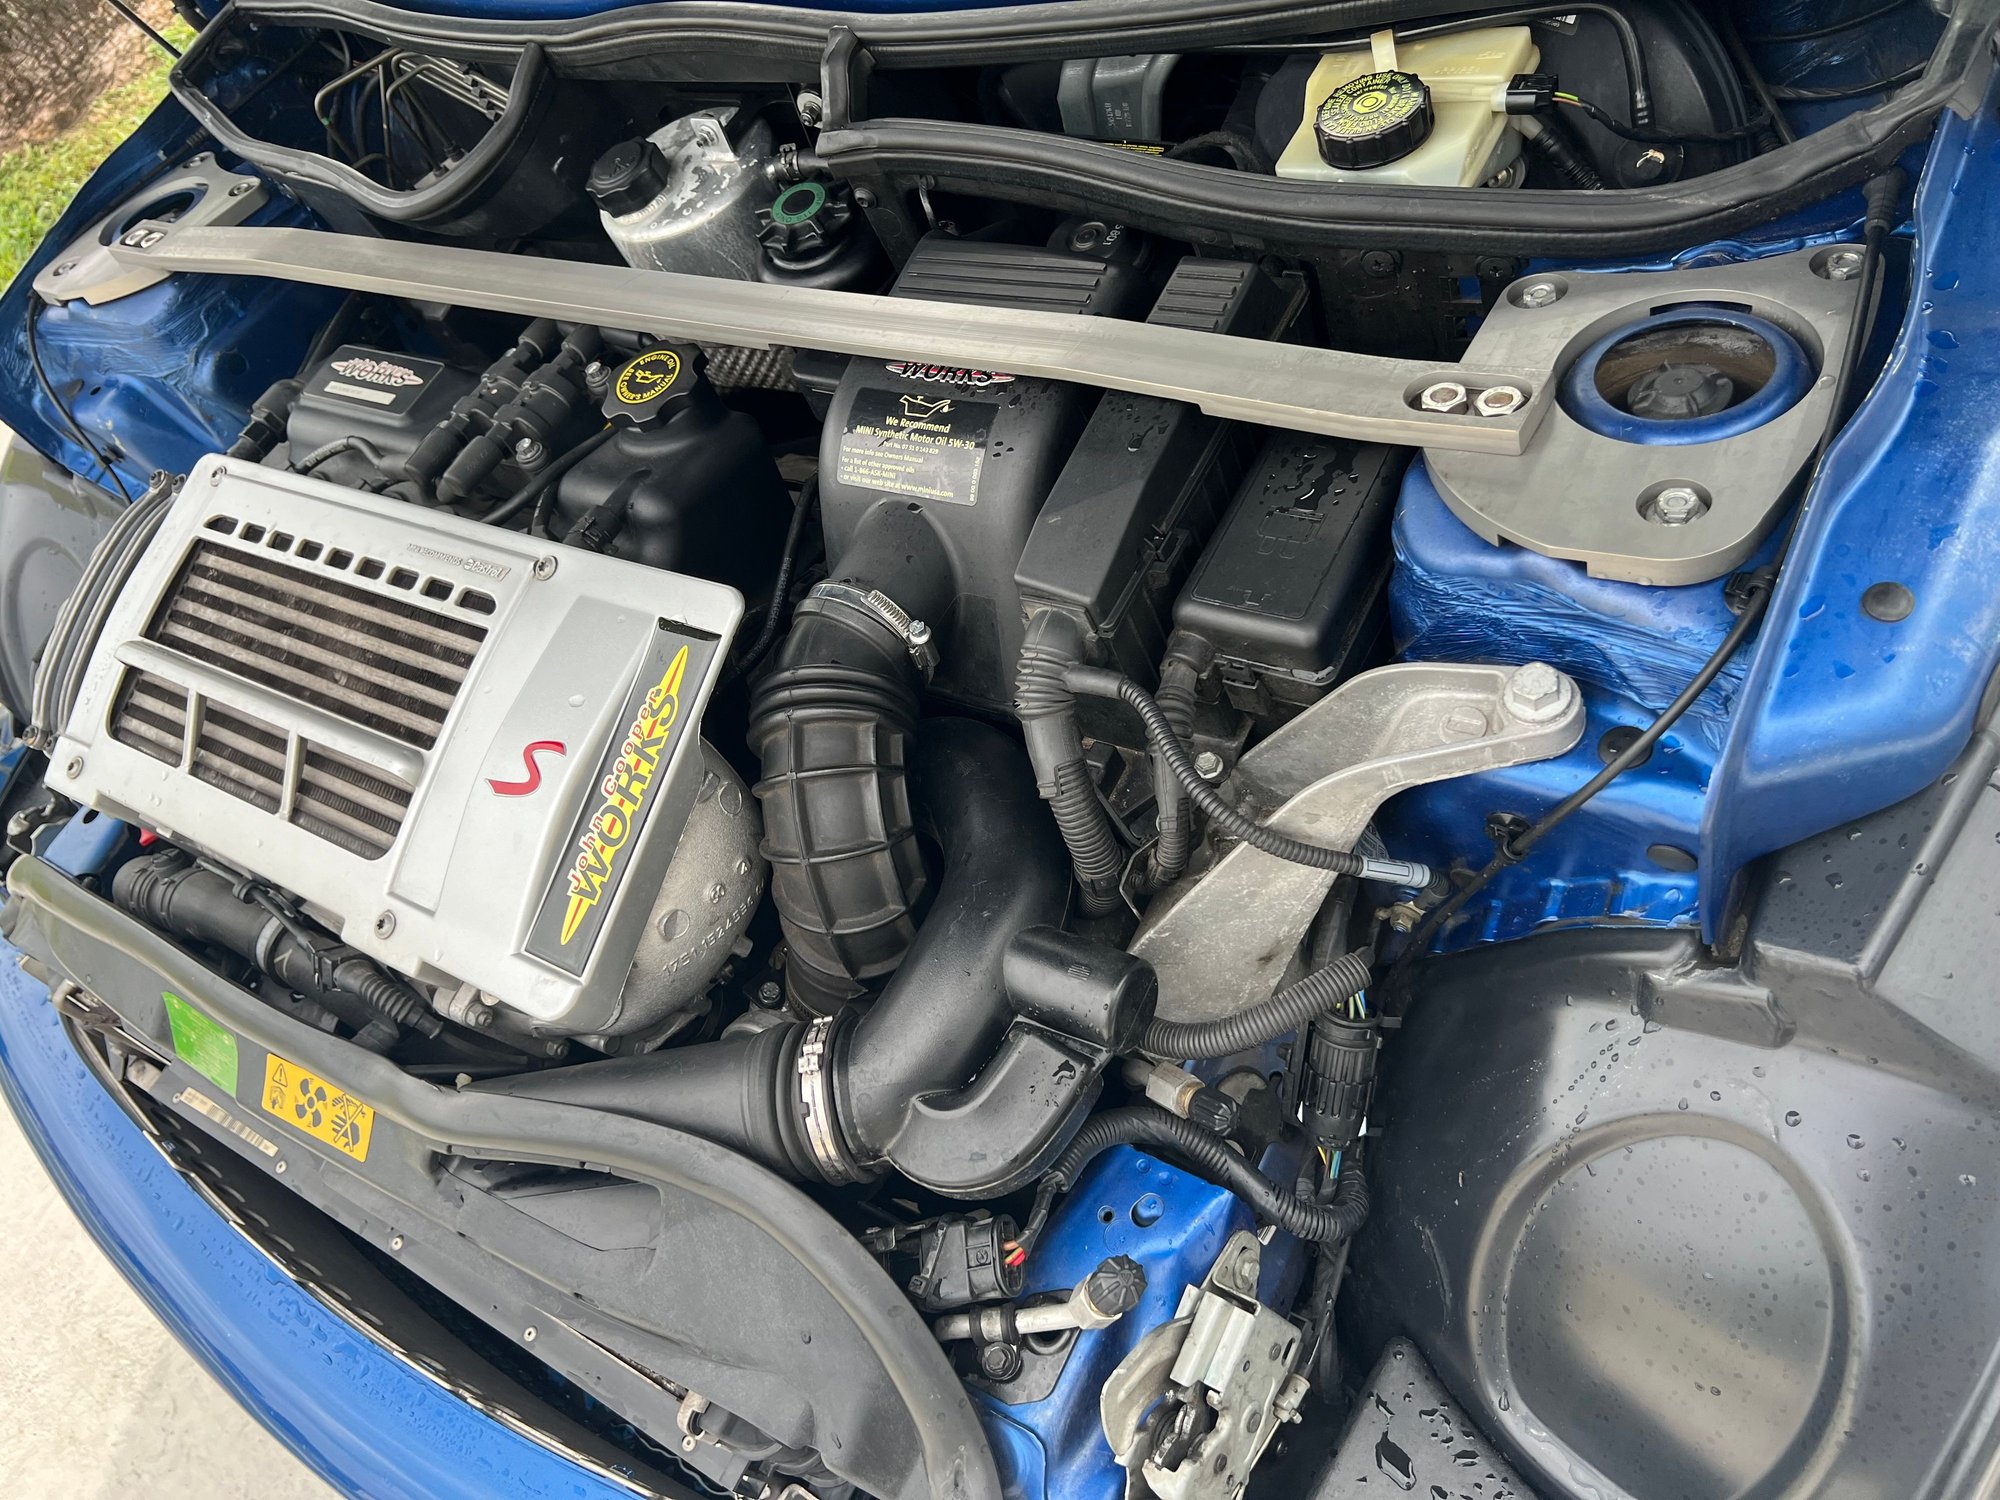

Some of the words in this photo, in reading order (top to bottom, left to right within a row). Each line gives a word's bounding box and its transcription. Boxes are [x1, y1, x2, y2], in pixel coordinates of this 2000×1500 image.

[1333, 75, 1373, 97] REMOVING
[1346, 78, 1391, 95] CONTAINER
[639, 354, 669, 366] ENGINE
[667, 357, 677, 370] OIL
[341, 362, 411, 386] WORKS
[624, 368, 635, 381] SEE
[643, 373, 674, 398] MANUAL
[885, 415, 899, 426] We
[900, 418, 951, 433] Recommend
[855, 424, 874, 436] MINI
[874, 427, 909, 441] Synthetic
[910, 432, 934, 444] Motor
[935, 436, 948, 446] Oil
[948, 438, 976, 450] 5W-30
[881, 463, 906, 472] approved
[904, 454, 924, 463] Manual
[901, 484, 954, 497] www.miniusa.com
[472, 560, 503, 578] Castrol
[486, 740, 567, 797] S
[567, 813, 605, 893] John
[602, 687, 663, 797] Cooper
[572, 693, 678, 903] WORKS
